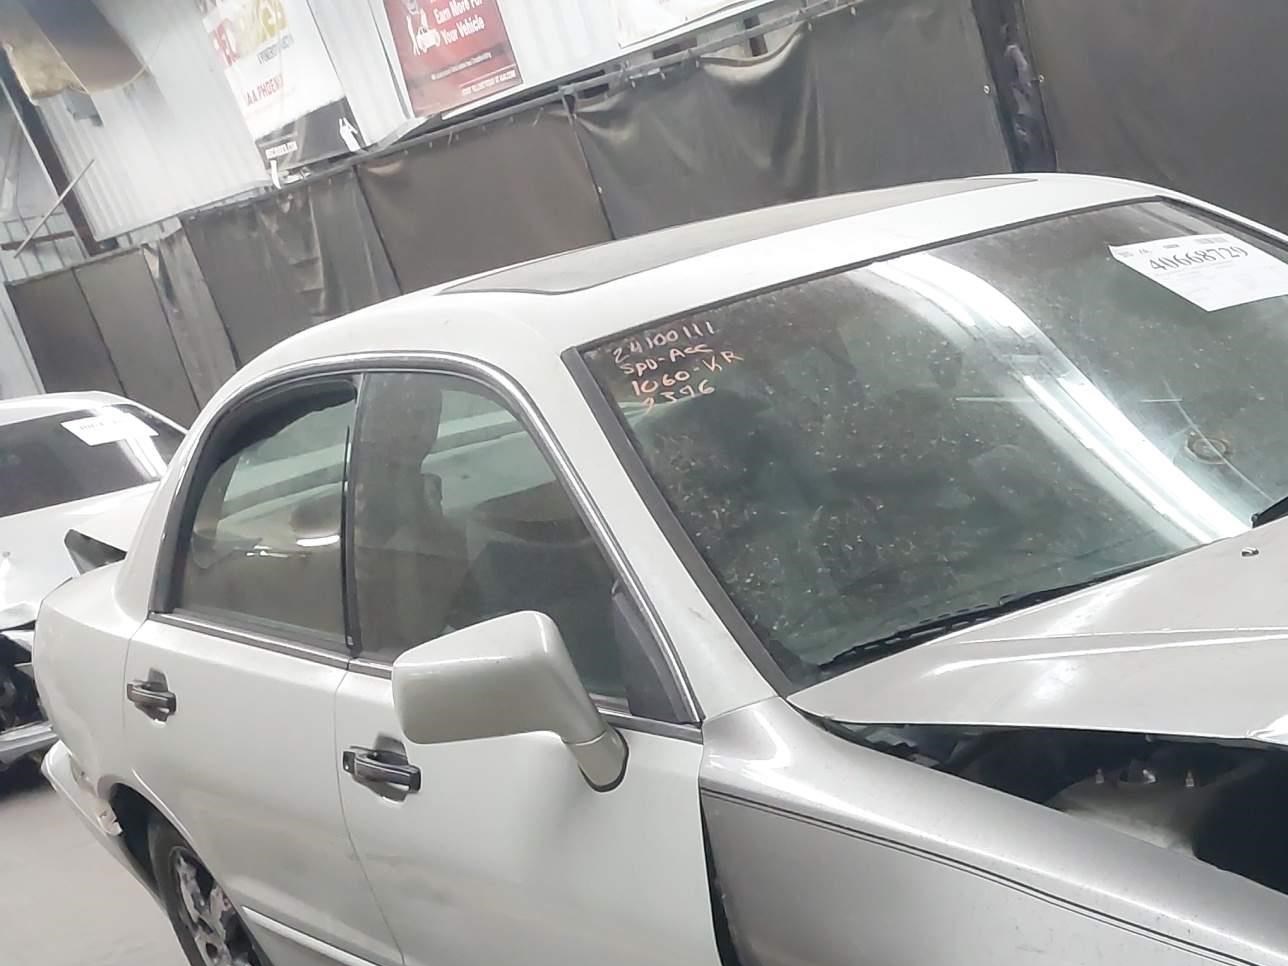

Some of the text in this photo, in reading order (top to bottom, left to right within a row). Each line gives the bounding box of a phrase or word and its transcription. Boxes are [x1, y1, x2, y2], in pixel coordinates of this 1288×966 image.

[440, 15, 484, 45] Your Vehicle
[1149, 246, 1249, 271] 40668729
